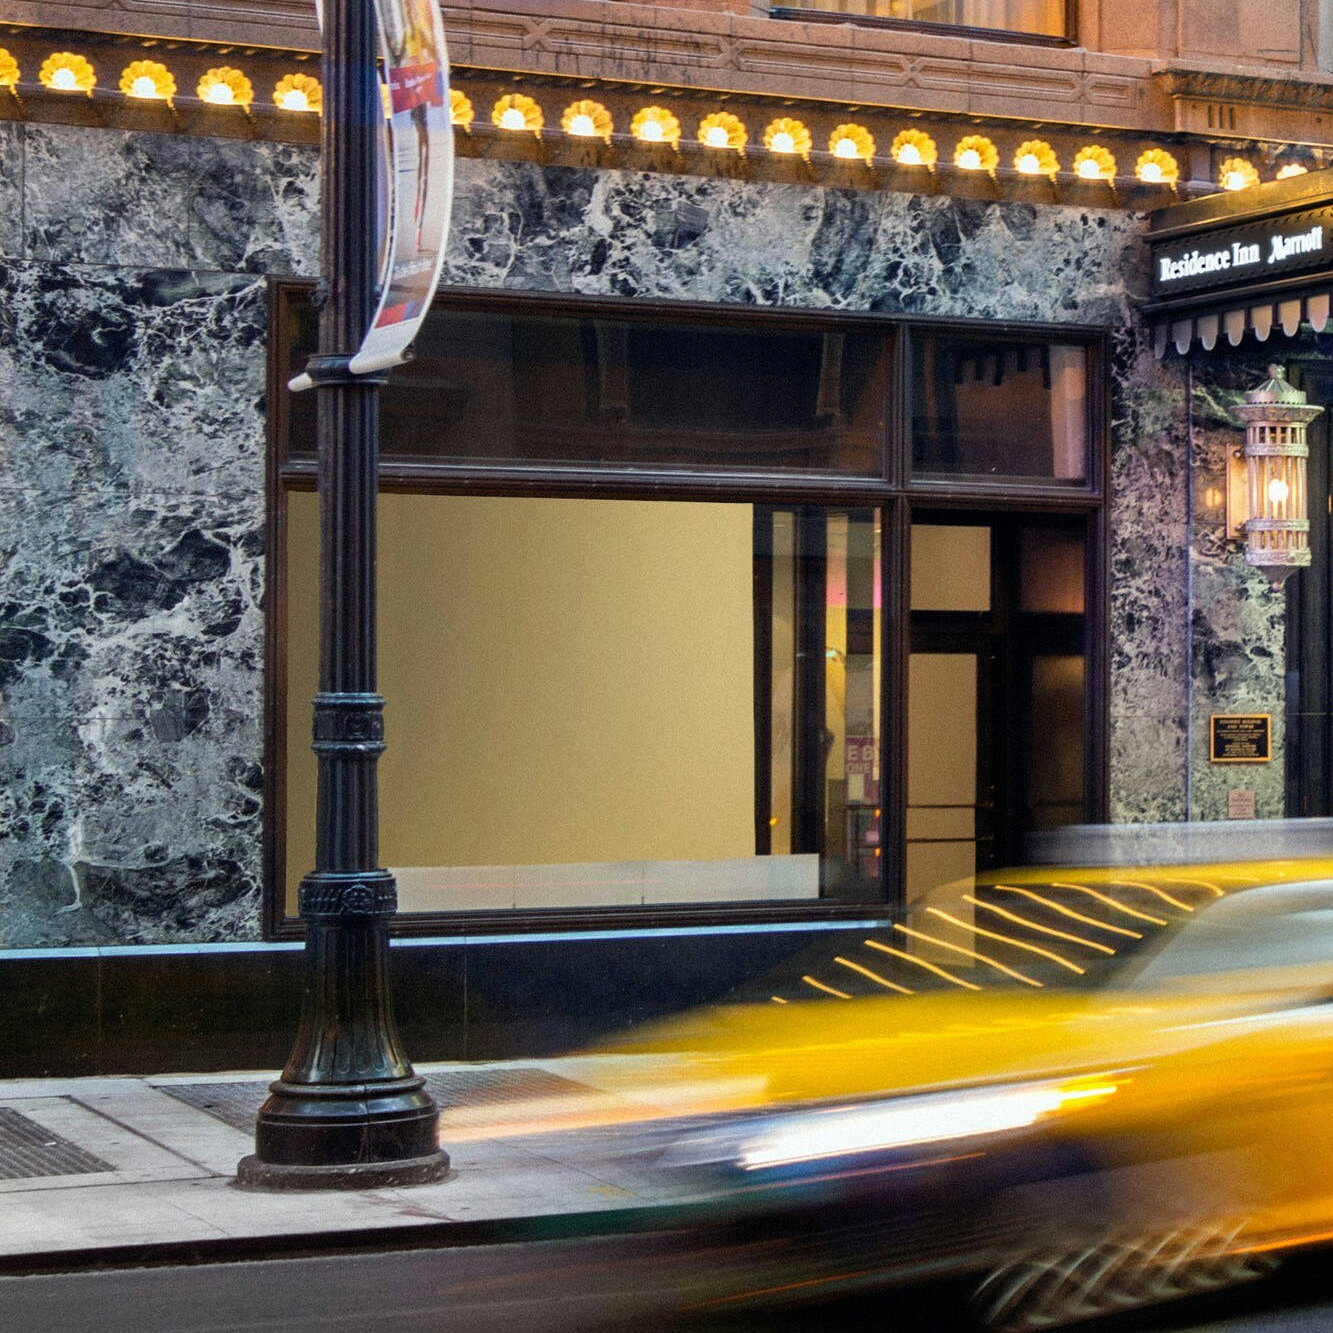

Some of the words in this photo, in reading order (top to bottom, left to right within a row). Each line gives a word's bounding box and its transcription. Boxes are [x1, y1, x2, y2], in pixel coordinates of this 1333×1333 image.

[1160, 250, 1231, 281] Residence
[1232, 243, 1260, 266] Inn
[1267, 226, 1323, 264] Marriott
